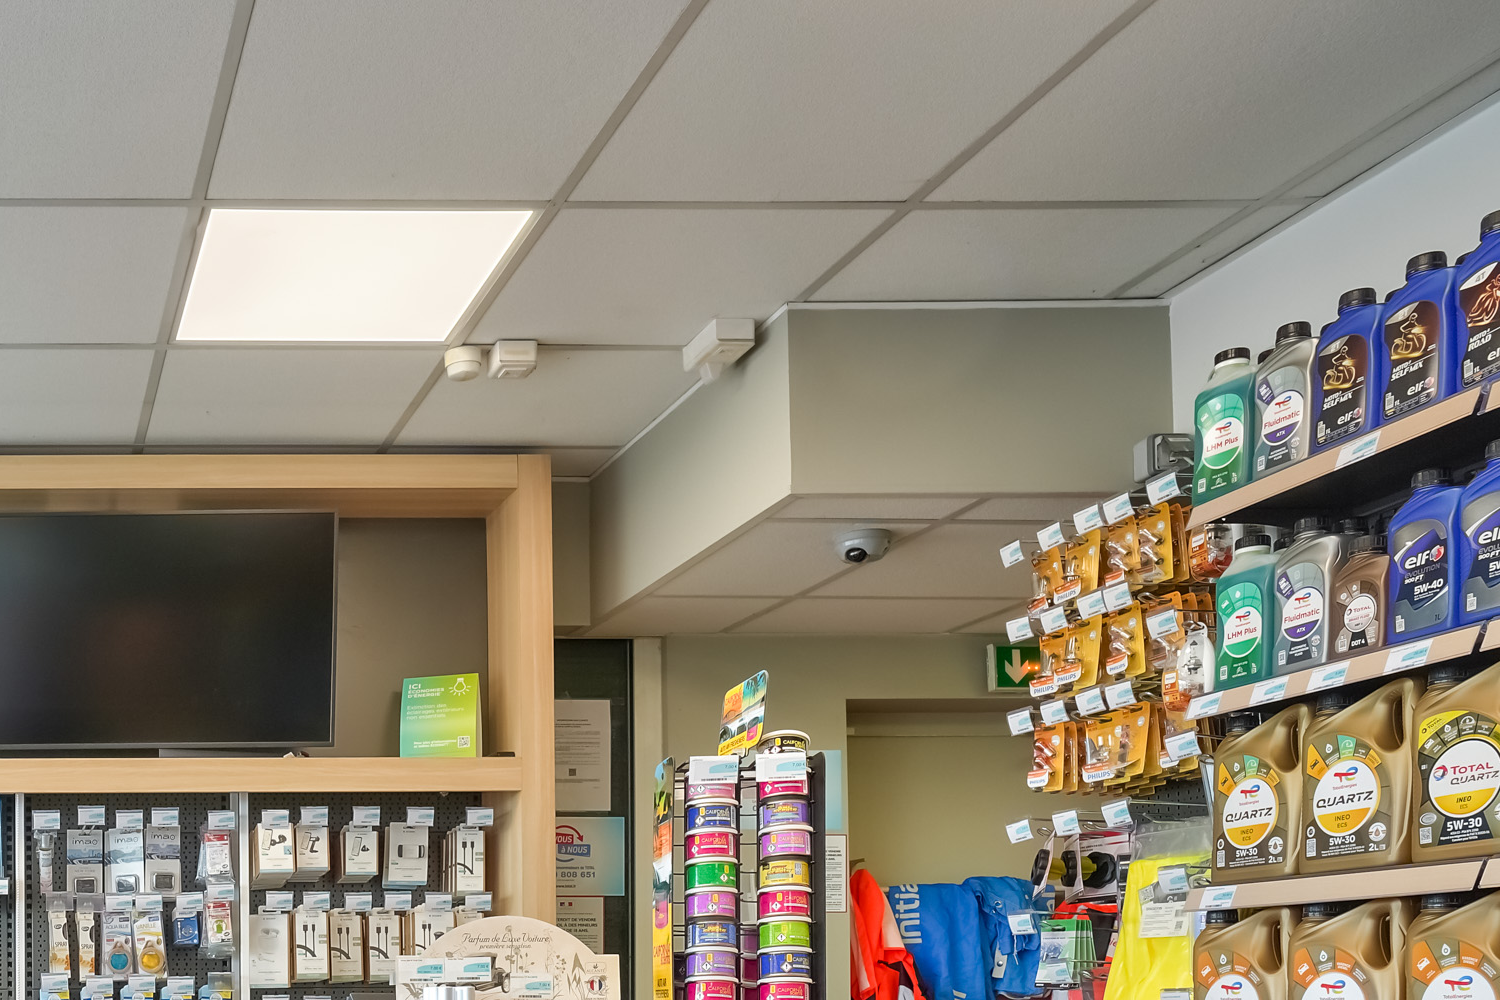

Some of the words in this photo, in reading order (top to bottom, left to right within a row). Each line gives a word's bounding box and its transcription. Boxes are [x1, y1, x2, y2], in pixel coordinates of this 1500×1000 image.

[1264, 410, 1300, 430] Fluidmatic
[1404, 552, 1431, 569] elf
[1413, 578, 1443, 595] 5W-40
[1057, 589, 1077, 602] PHILIPS
[1227, 630, 1243, 640] LHM
[1244, 625, 1257, 636] Plus
[1351, 639, 1361, 647] DOT
[1087, 770, 1111, 780] PHILIPS
[1316, 790, 1373, 809] QUARTZ
[1334, 814, 1350, 822] INEO
[72, 838, 98, 846] imao
[1329, 835, 1356, 845] 5W-30
[1369, 843, 1379, 851] 2L
